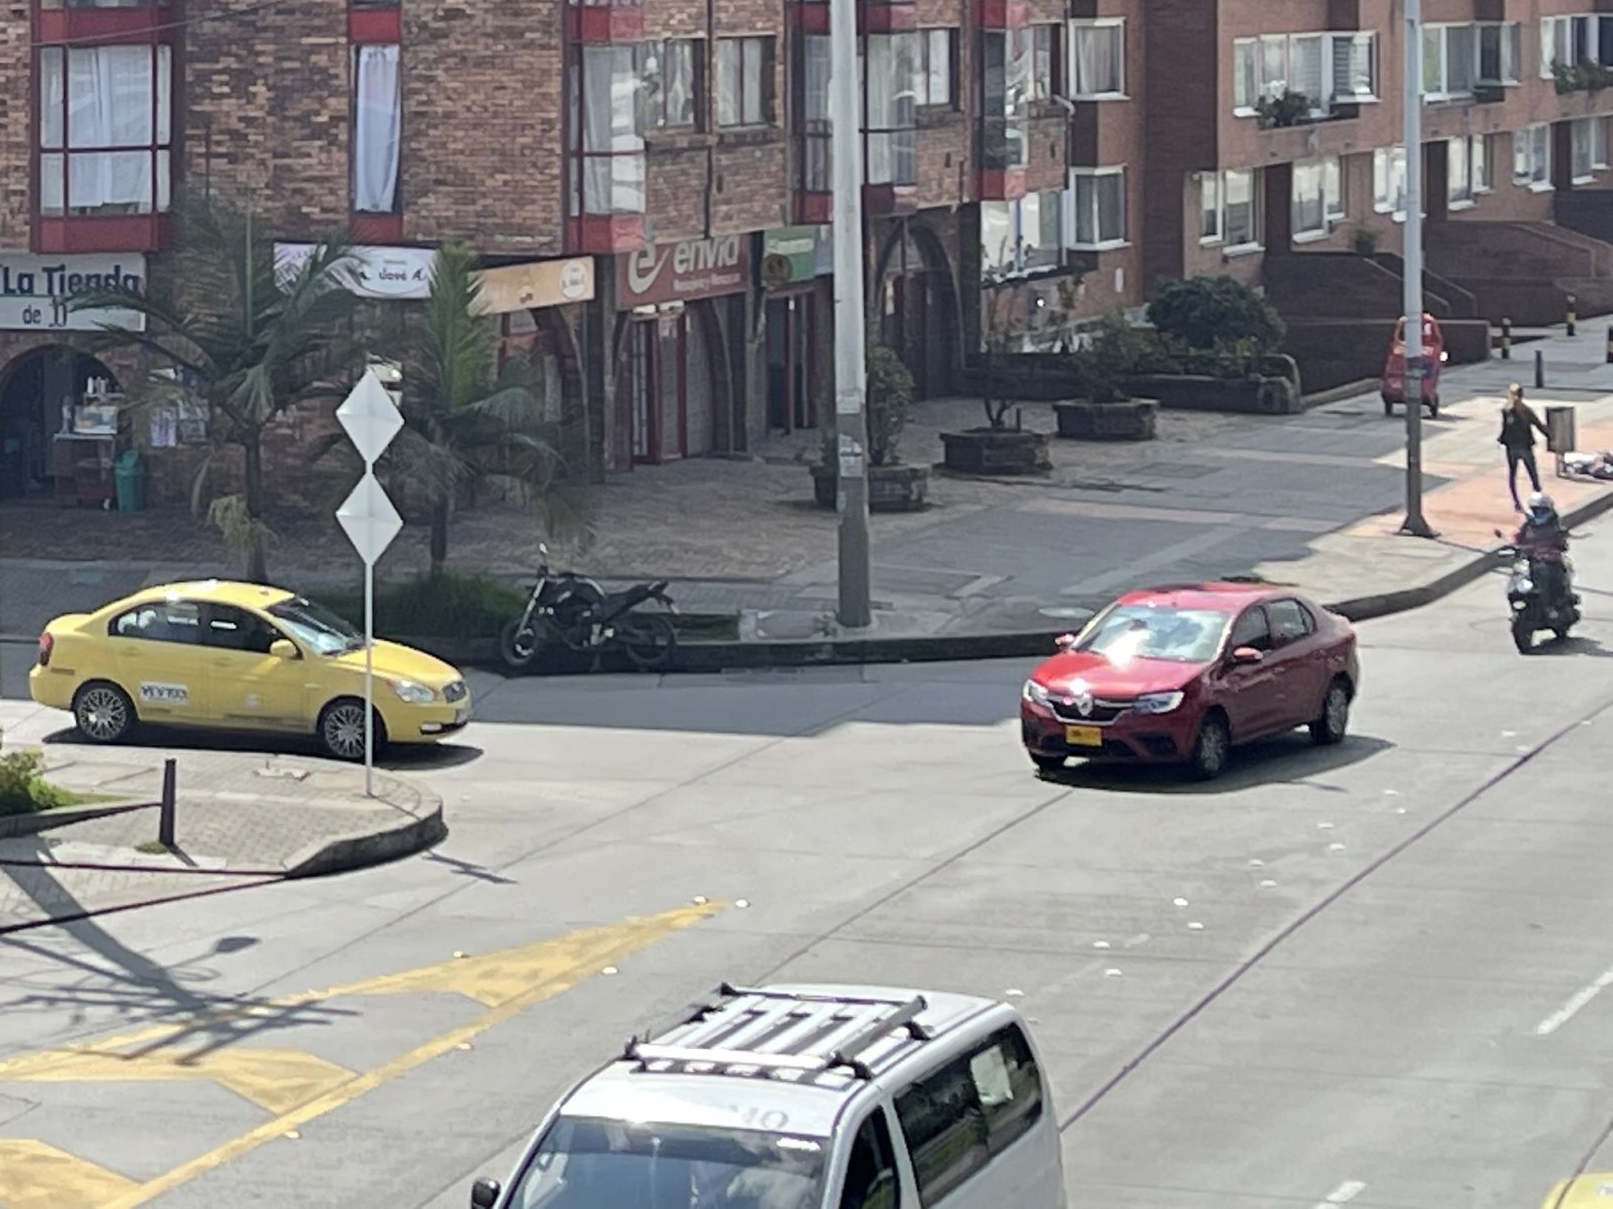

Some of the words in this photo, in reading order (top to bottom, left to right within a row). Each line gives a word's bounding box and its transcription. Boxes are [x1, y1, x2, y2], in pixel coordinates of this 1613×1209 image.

[2, 266, 35, 295] La
[42, 263, 141, 298] Tienda
[23, 305, 42, 325] de
